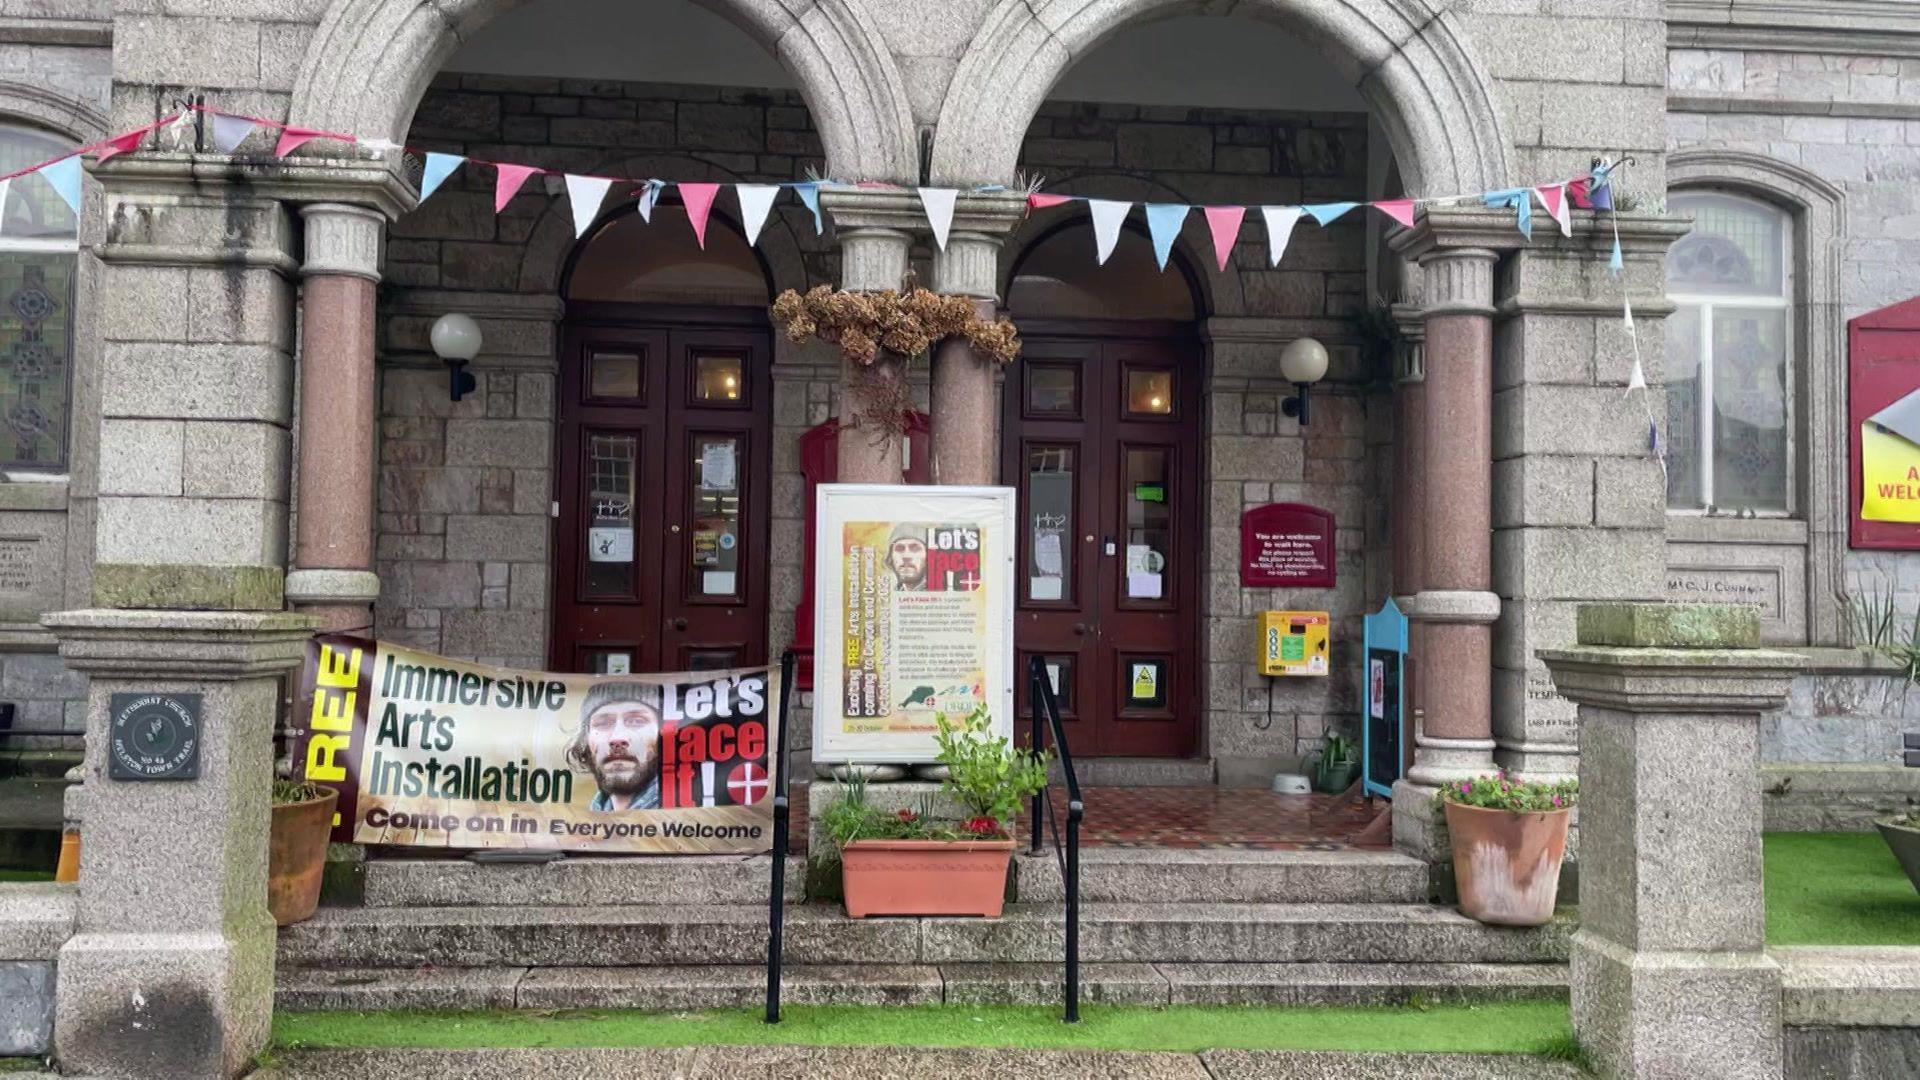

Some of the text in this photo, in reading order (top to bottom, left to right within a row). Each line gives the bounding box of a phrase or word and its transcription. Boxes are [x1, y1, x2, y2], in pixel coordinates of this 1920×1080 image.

[928, 527, 978, 550] Let's
[928, 550, 979, 572] face
[847, 545, 863, 716] Exciting FREE Arts Installation
[863, 546, 878, 716] coming to Devon and Cornwall
[381, 654, 567, 712] Immersive
[662, 674, 764, 720] Let's
[305, 643, 363, 827] REE
[374, 702, 456, 752] Arts
[660, 720, 766, 763] face
[146, 760, 173, 774] TOWN
[368, 751, 574, 805] Installation
[661, 760, 716, 809] it!
[365, 806, 763, 840] Come on in Everyone Welcome
